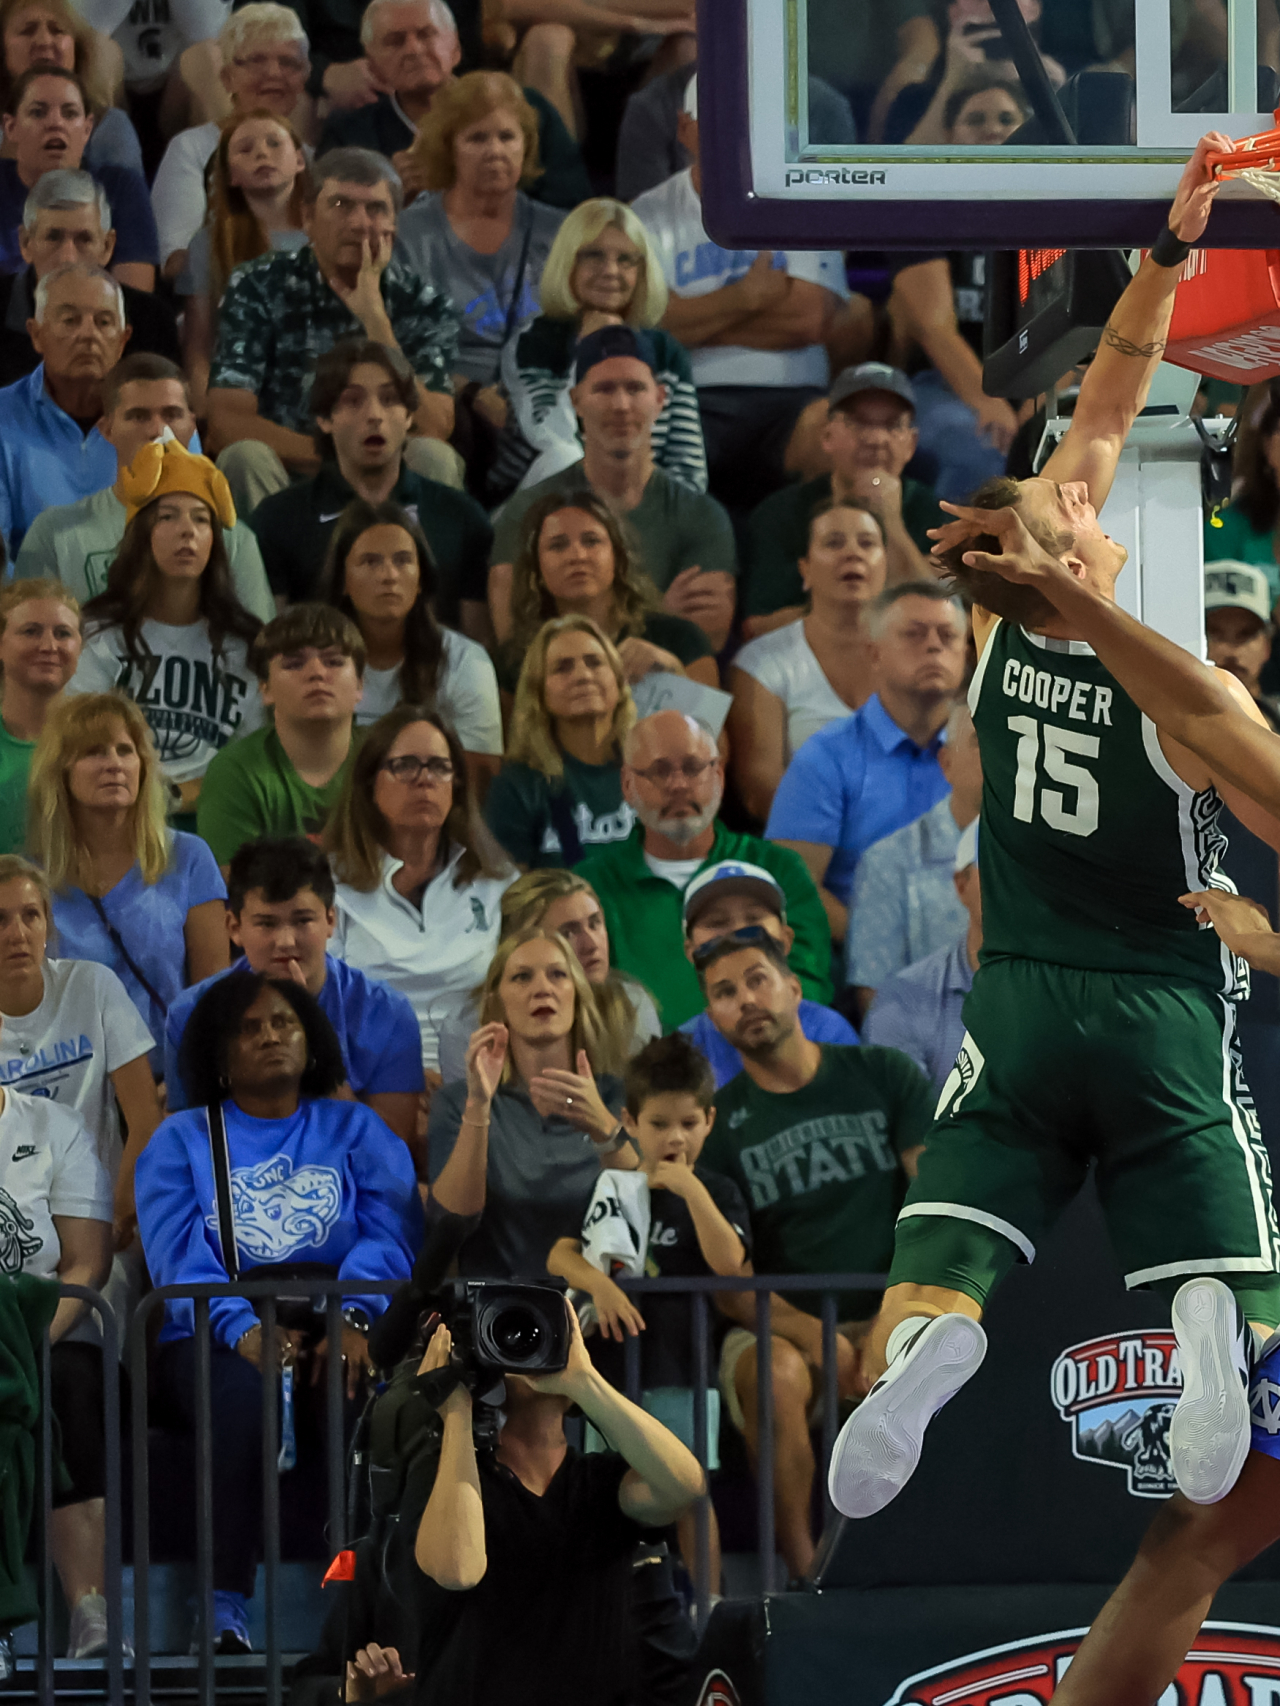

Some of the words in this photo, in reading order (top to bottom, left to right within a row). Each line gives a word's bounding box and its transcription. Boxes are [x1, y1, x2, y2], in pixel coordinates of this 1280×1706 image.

[115, 655, 248, 729] ZZONE
[1003, 658, 1113, 727] COOPER
[1007, 715, 1101, 838] 15
[740, 1109, 897, 1210] STATE
[1056, 1355, 1118, 1407] OLD
